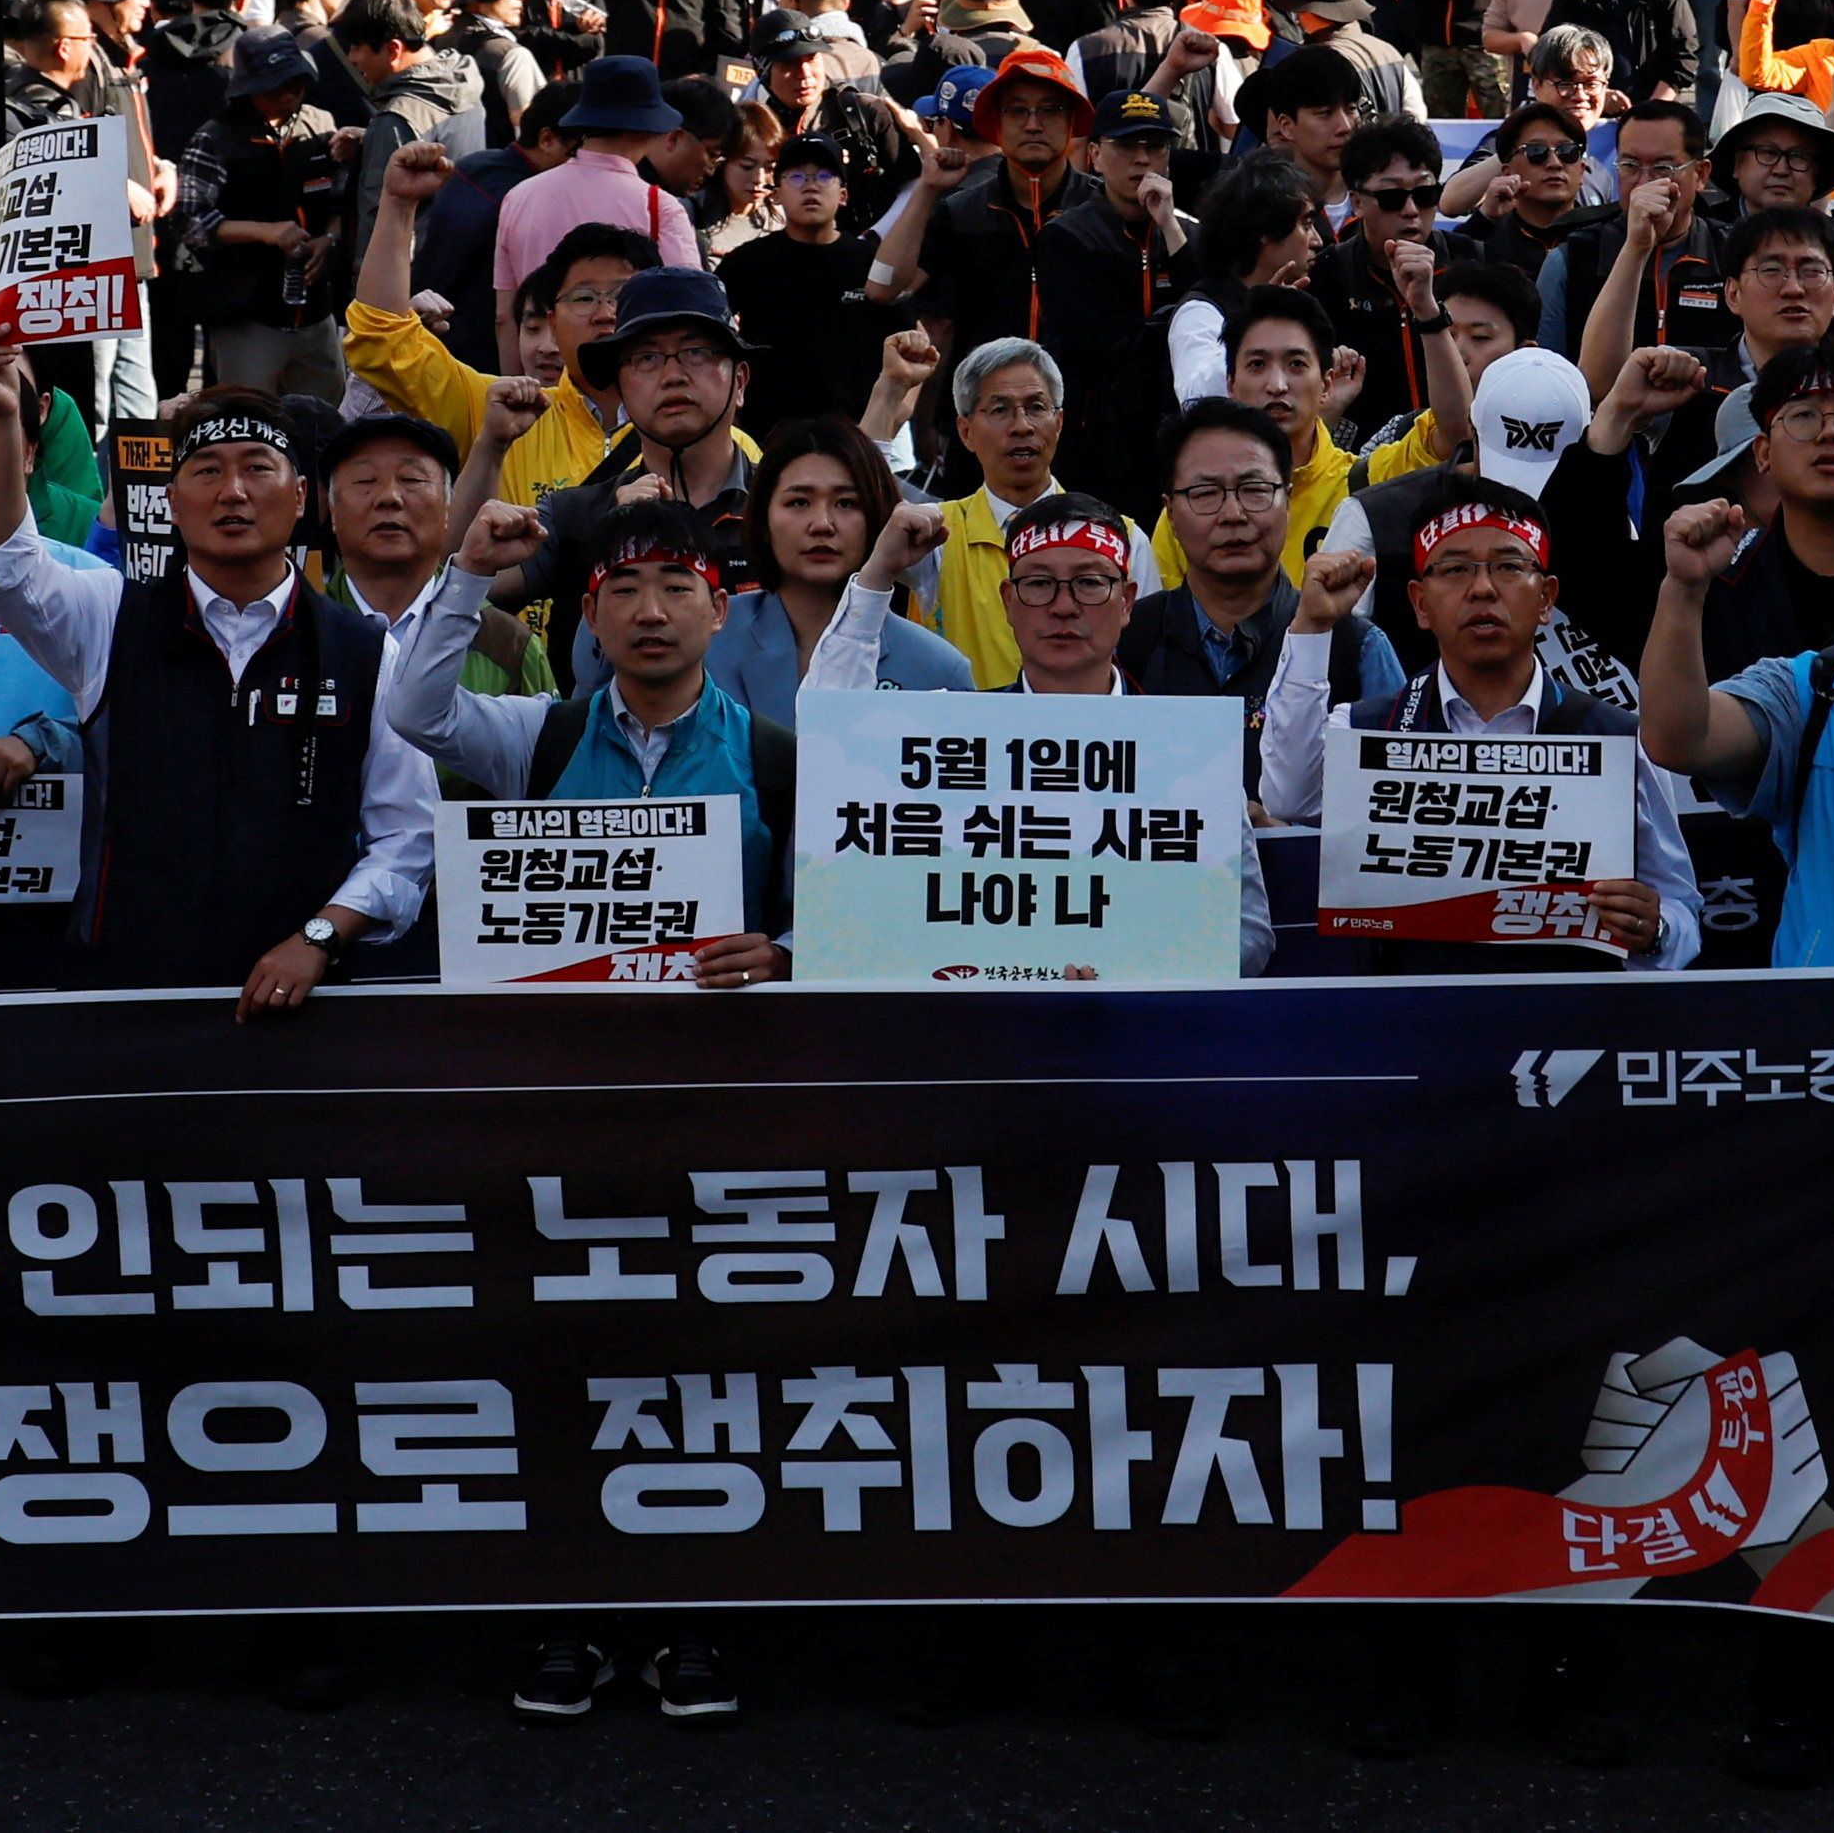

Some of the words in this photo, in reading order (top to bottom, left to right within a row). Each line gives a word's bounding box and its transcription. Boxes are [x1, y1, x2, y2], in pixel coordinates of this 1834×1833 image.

[15, 274, 124, 335] 쟁취!
[122, 439, 151, 467] 가자!
[1084, 524, 1125, 566] 투쟁
[900, 736, 988, 793] 5월
[1005, 736, 1137, 795] 1일에
[1385, 741, 1468, 772] 열사의
[1474, 743, 1590, 774] 염원이다!
[491, 809, 572, 837] 열사의
[577, 806, 695, 836] 염원이다!
[834, 803, 941, 860] 처음
[964, 805, 1072, 862] 쉬는
[1092, 807, 1204, 864] 사람
[1359, 833, 1592, 885] 노동기본권
[477, 900, 697, 945] 노동기본권
[925, 871, 1037, 928] 나야
[1054, 874, 1110, 929] 나
[1350, 917, 1394, 931] 민주노총
[527, 1167, 1005, 1305] 노동자
[1055, 1160, 1419, 1298] 시대,
[1716, 1364, 1761, 1455] 투쟁
[587, 1363, 1397, 1536] 쟁취하자!
[1563, 1482, 1697, 1573] 단결
